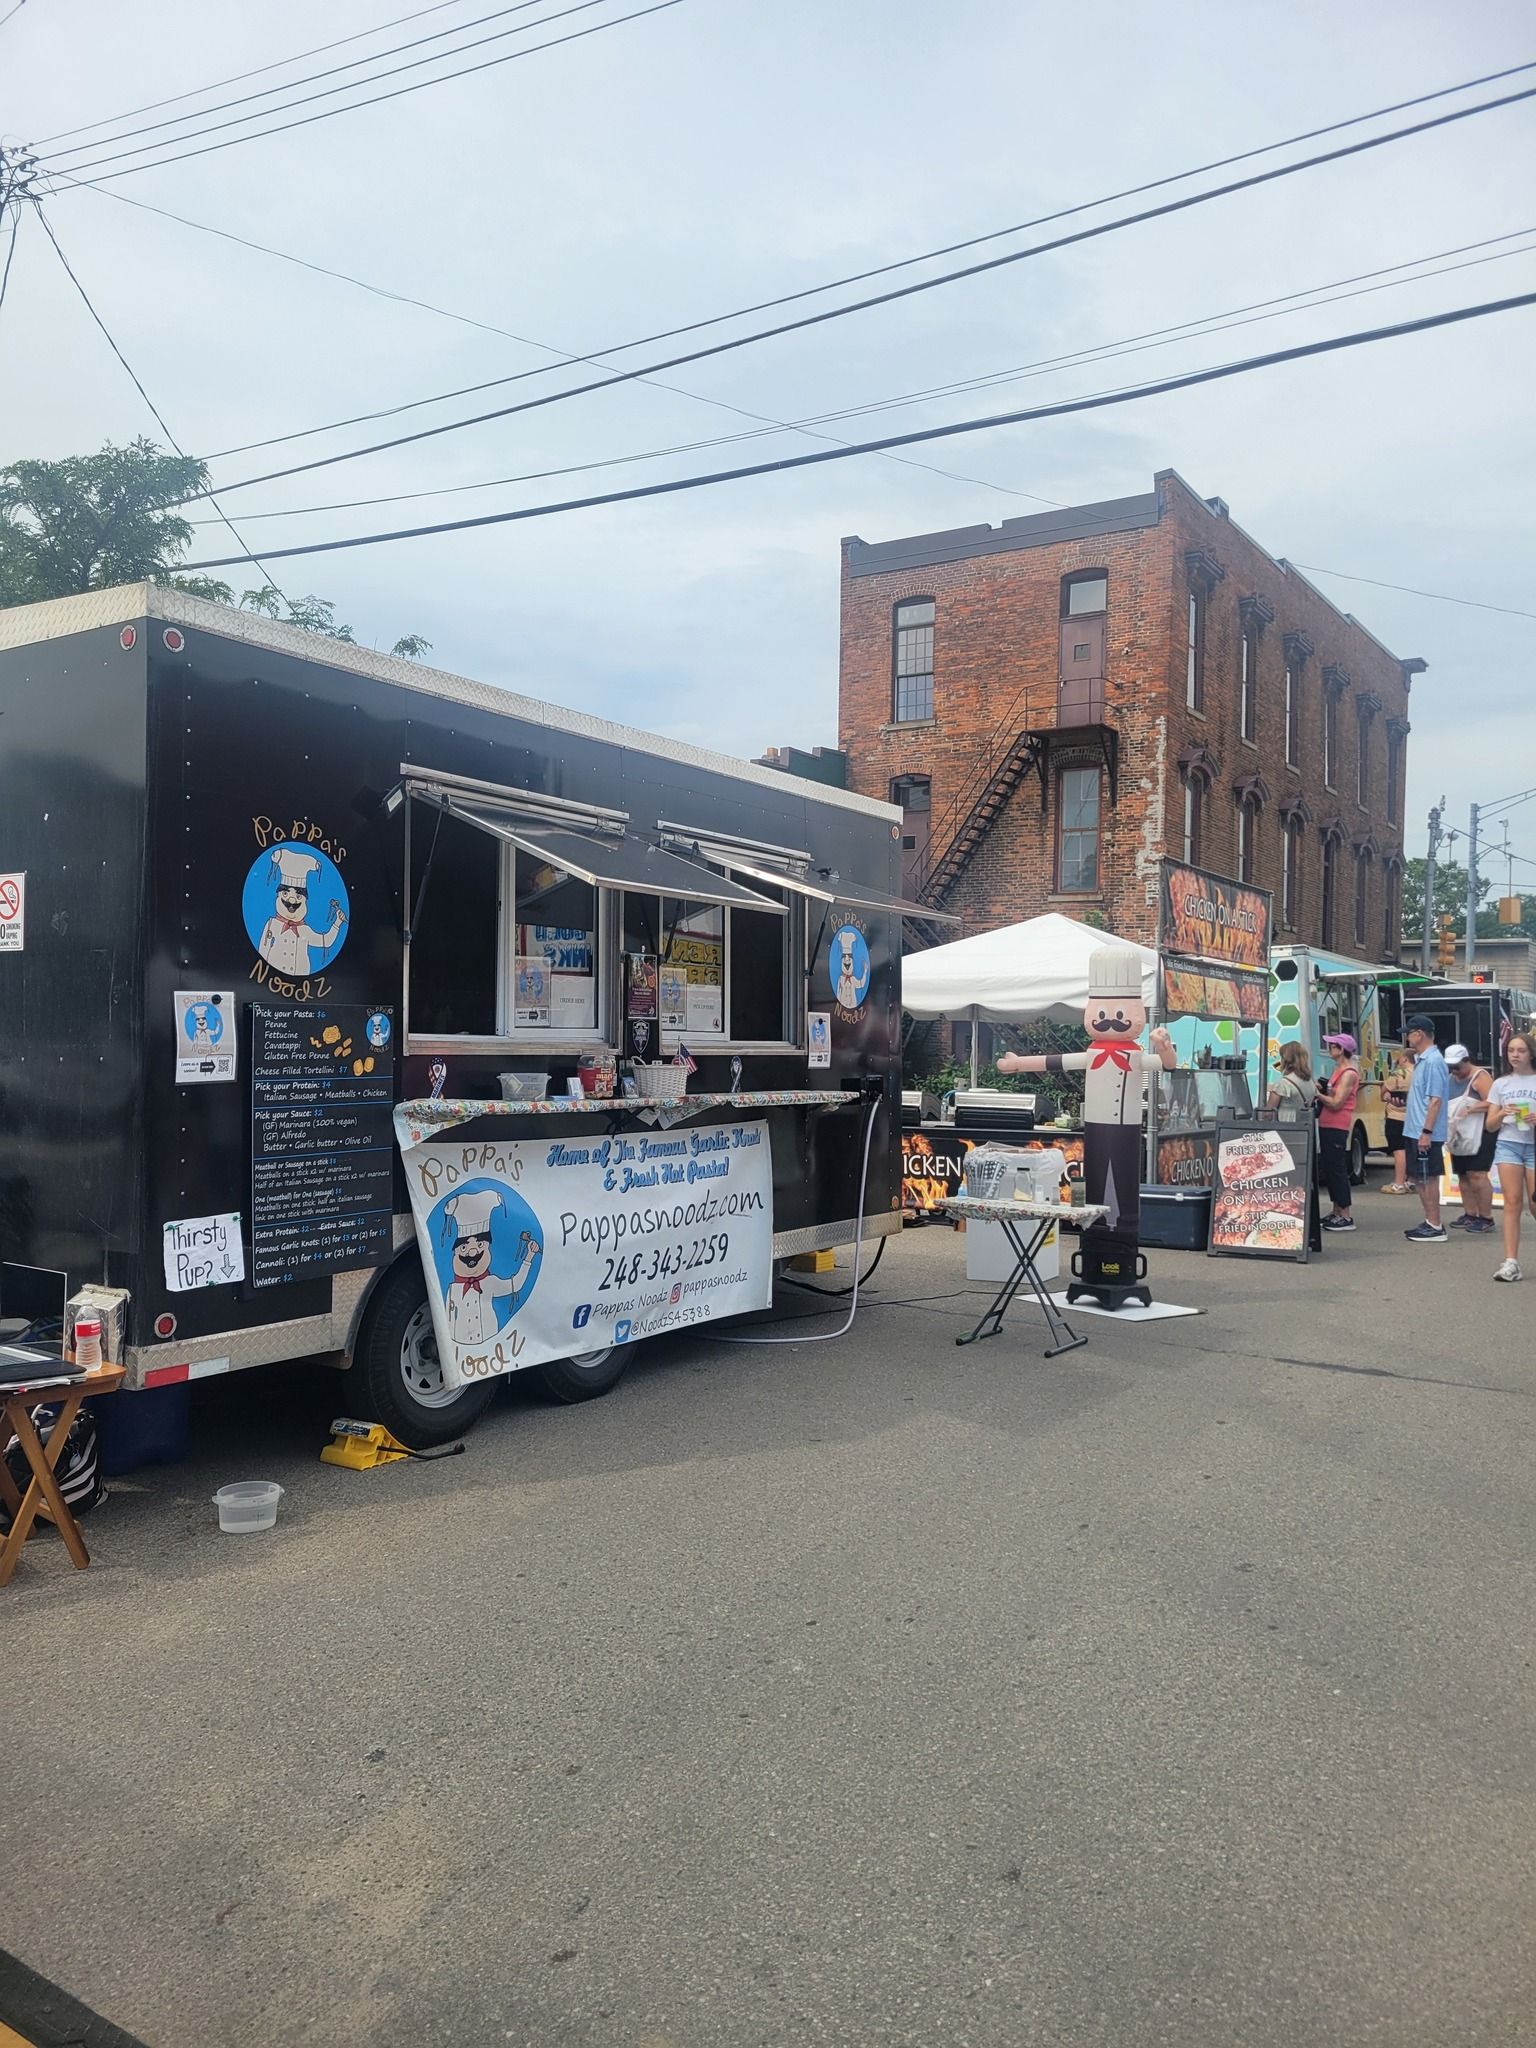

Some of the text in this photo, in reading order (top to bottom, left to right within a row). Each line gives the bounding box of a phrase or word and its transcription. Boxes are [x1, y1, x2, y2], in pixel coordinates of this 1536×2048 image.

[252, 816, 346, 863] Pappa's
[1185, 894, 1256, 932] CHICKEN ON A STICK
[830, 911, 866, 935] Pappa's
[249, 960, 331, 1002] Noodz
[256, 1009, 271, 1017] Pick
[274, 1011, 291, 1019] your
[834, 1002, 866, 1024] Noodz
[265, 1020, 287, 1028] Penne
[264, 1031, 298, 1039] Fettucine
[264, 1041, 301, 1051] Cavatappi
[264, 1052, 288, 1060] Gluten
[255, 1067, 279, 1075] Cheese
[304, 1065, 335, 1074] Tortellini
[273, 1083, 290, 1092] your
[292, 1081, 320, 1089] Protein:
[322, 1081, 331, 1089] $4
[264, 1093, 287, 1101] Italian
[290, 1092, 317, 1101] Sausage
[363, 1089, 387, 1097] Chicken
[272, 1112, 288, 1121] your
[291, 1110, 312, 1118] Sauce:
[314, 1109, 323, 1117] $2
[263, 1122, 277, 1131] (GF)
[279, 1120, 311, 1129] Marinara
[337, 1117, 357, 1127] vegan)
[263, 1130, 306, 1142] (GF) Alfredo
[264, 1136, 372, 1151] Butter Garlic butter Olive Oil
[1242, 1132, 1265, 1143] STIR
[547, 1144, 589, 1167] Home
[592, 1140, 611, 1168] of
[613, 1140, 635, 1165] The
[638, 1138, 687, 1163] Famous
[691, 1131, 729, 1157] Garlic
[1226, 1143, 1284, 1156] FRIED RICE
[418, 1144, 524, 1198] Pappa's
[903, 1155, 961, 1177] ICKEN
[1171, 1159, 1205, 1182] CHICKEN
[619, 1166, 659, 1193] Fresh
[661, 1163, 685, 1184] Hot
[687, 1157, 729, 1184] Pasta!
[1230, 1177, 1289, 1190] CHICKEN
[1224, 1191, 1299, 1206] ON A STICK
[559, 1189, 764, 1254] Pappasnoodz.com
[1244, 1212, 1267, 1220] STIR
[256, 1230, 273, 1239] Extra
[275, 1228, 299, 1237] Protein:
[320, 1222, 336, 1230] Extra
[1219, 1220, 1296, 1233] FRIED NOODLE
[165, 1218, 227, 1252] Thirsty
[255, 1245, 279, 1254] Famous
[281, 1241, 299, 1250] Garlic
[301, 1239, 319, 1248] Knots:
[321, 1236, 331, 1246] (1)
[332, 1235, 341, 1243] for
[359, 1231, 368, 1240] (2)
[369, 1229, 378, 1237] for
[256, 1258, 285, 1269] Cannoli:
[287, 1256, 299, 1266] (1)
[300, 1254, 311, 1262] for
[334, 1249, 344, 1259] (2)
[346, 1247, 356, 1255] for
[598, 1233, 728, 1291] 248-343-2259
[256, 1274, 293, 1287] Water: $2
[592, 1268, 748, 1320] Pappas Noodz pappasnoodz
